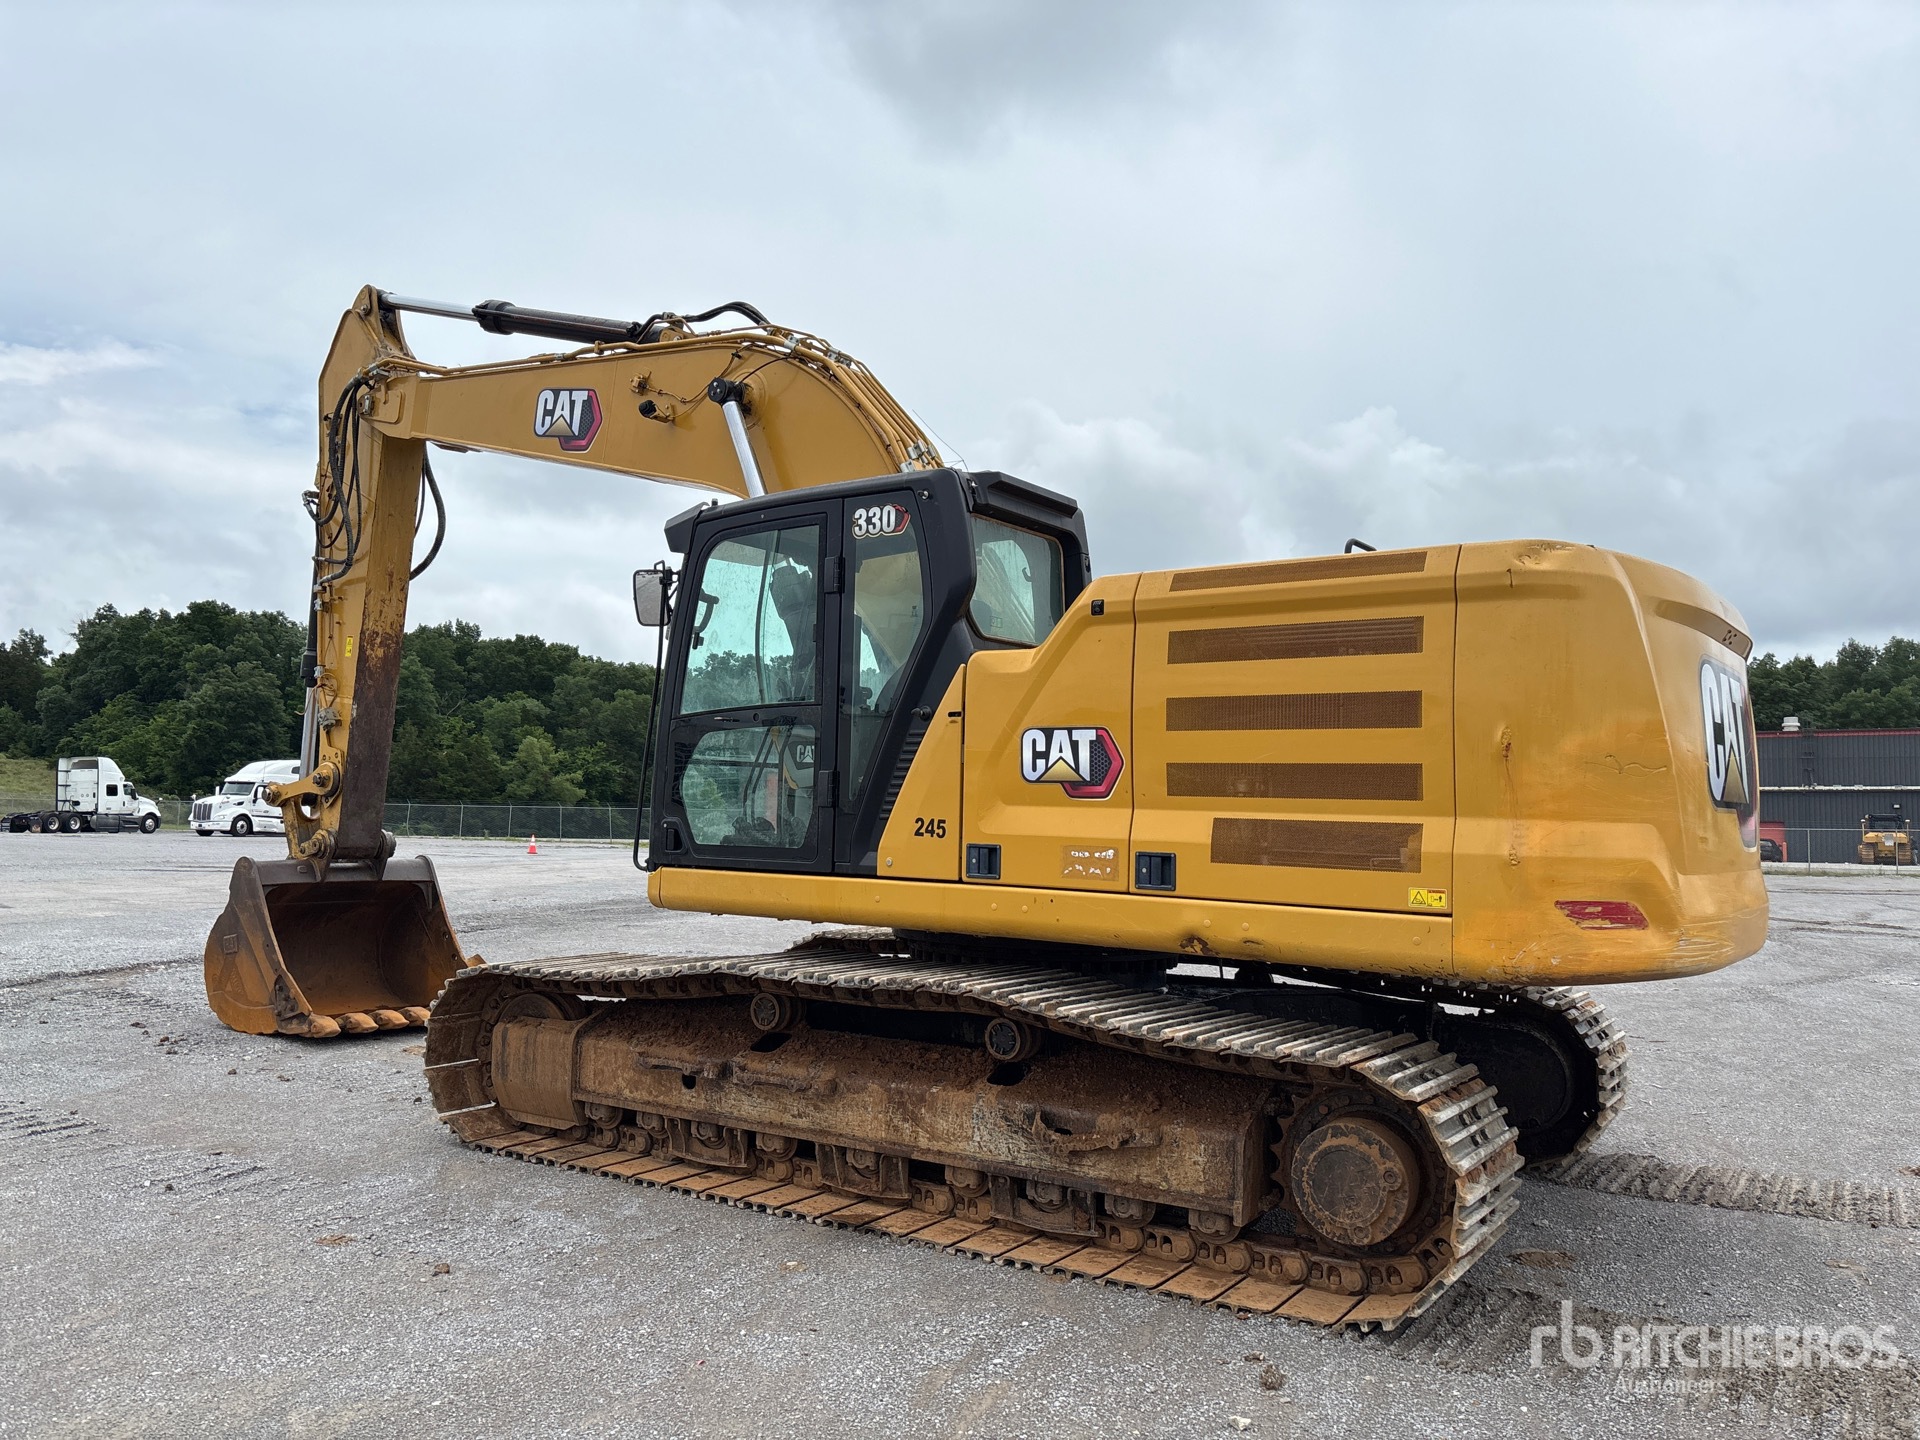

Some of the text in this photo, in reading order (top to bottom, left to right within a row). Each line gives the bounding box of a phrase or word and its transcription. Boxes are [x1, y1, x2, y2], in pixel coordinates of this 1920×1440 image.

[535, 389, 589, 437] CAT
[854, 505, 896, 536] 330
[1022, 728, 1097, 782] CAT
[1700, 663, 1749, 804] CAT
[914, 817, 947, 839] 245
